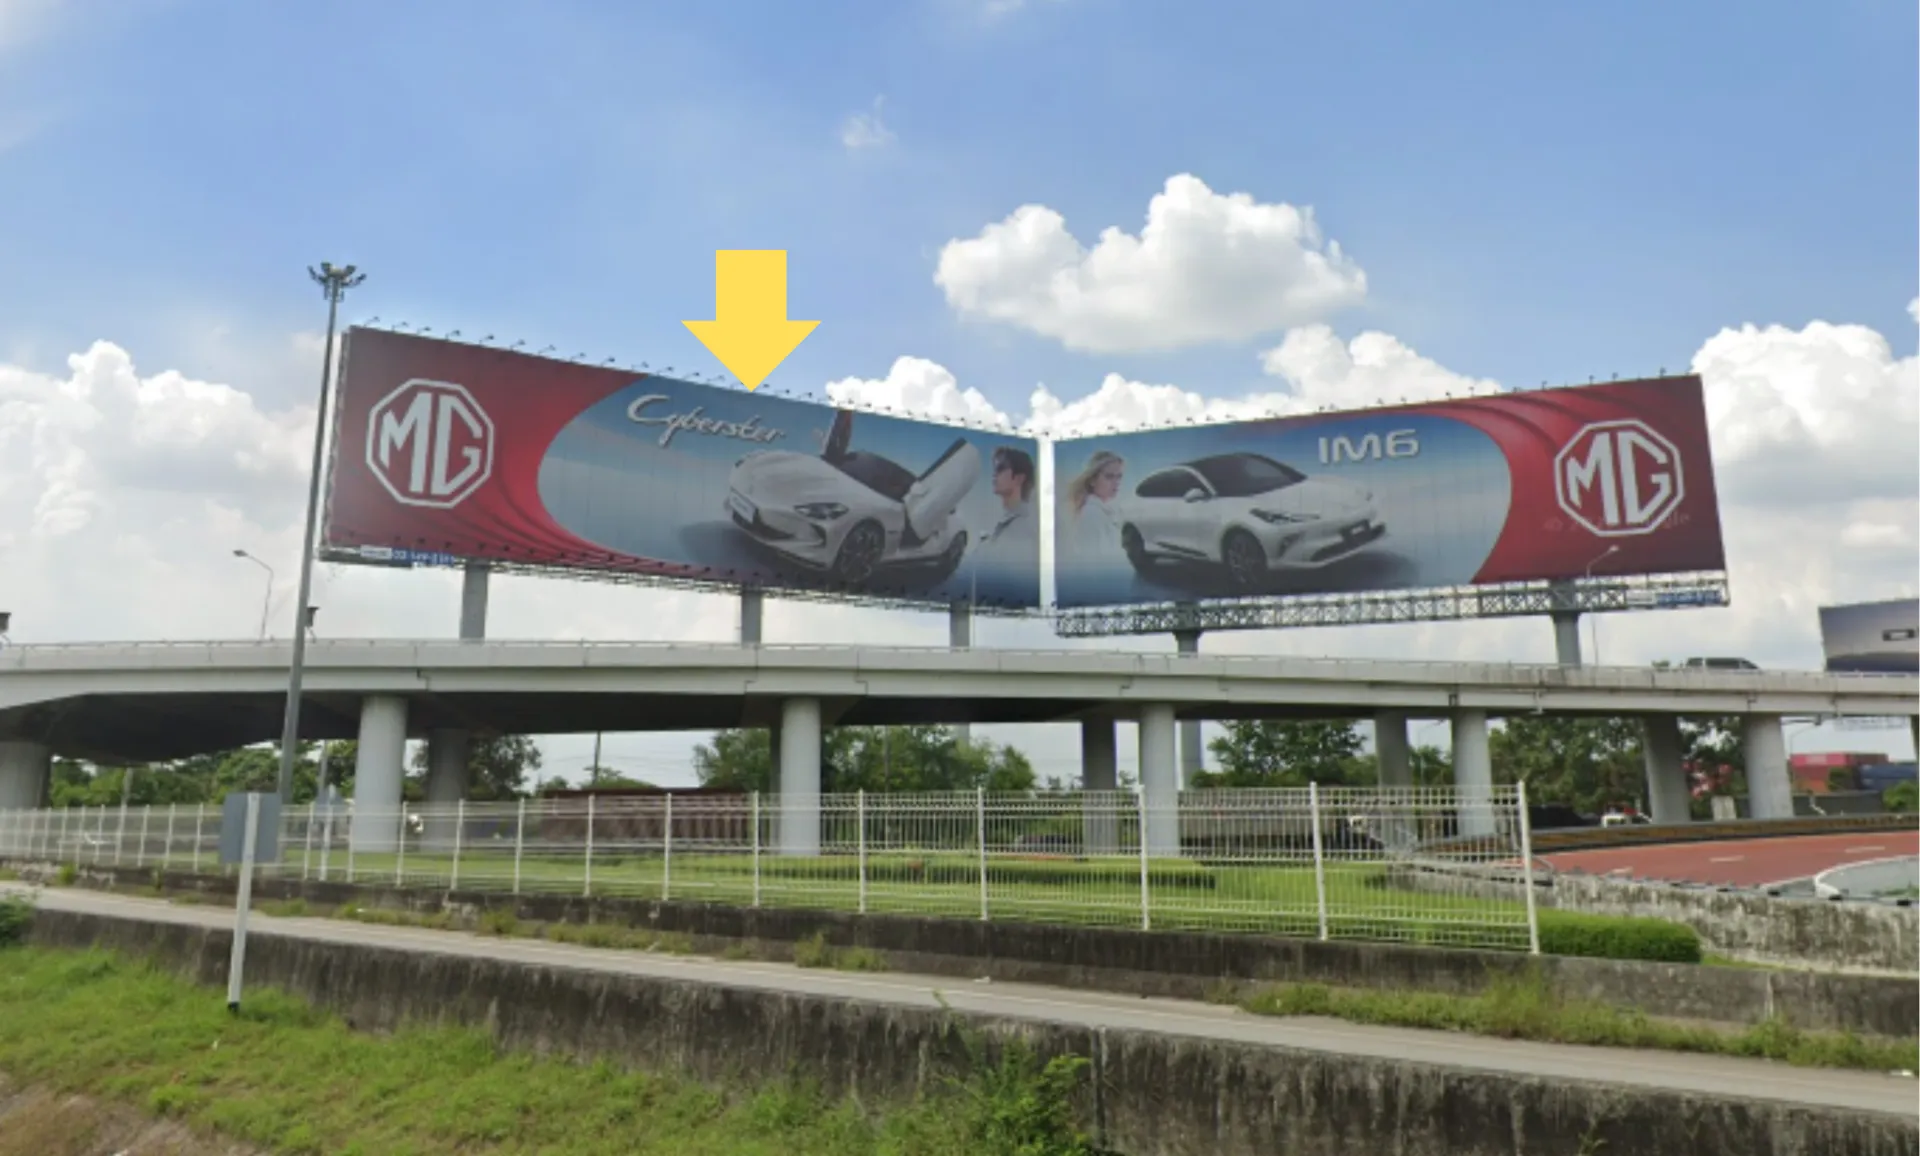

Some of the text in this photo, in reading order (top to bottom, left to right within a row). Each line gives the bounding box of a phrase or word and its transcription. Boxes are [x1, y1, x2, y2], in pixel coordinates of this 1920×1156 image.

[380, 392, 482, 495] MG
[627, 394, 787, 448] Cyberster
[1319, 429, 1419, 464] IM6
[1566, 431, 1671, 526] MG
